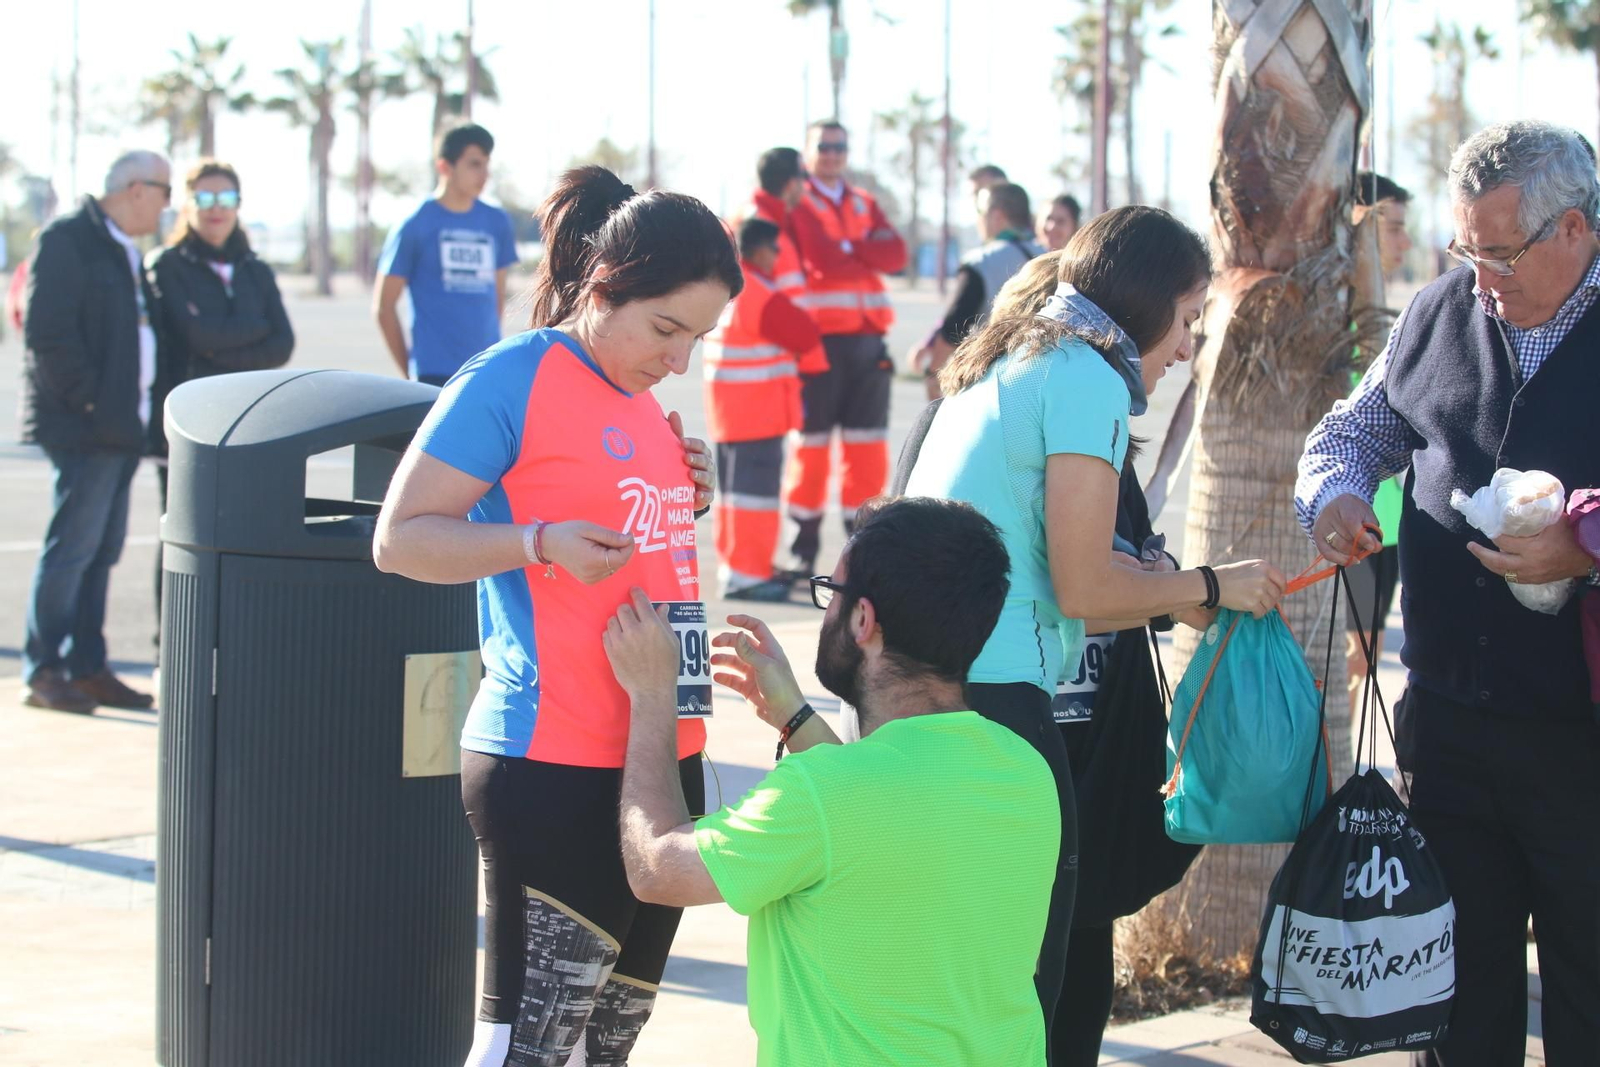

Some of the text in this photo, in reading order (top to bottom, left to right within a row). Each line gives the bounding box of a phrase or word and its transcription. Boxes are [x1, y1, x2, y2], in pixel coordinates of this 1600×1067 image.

[1343, 845, 1411, 910] edp
[1296, 936, 1384, 968] FIESTA
[1316, 968, 1343, 980] DEL
